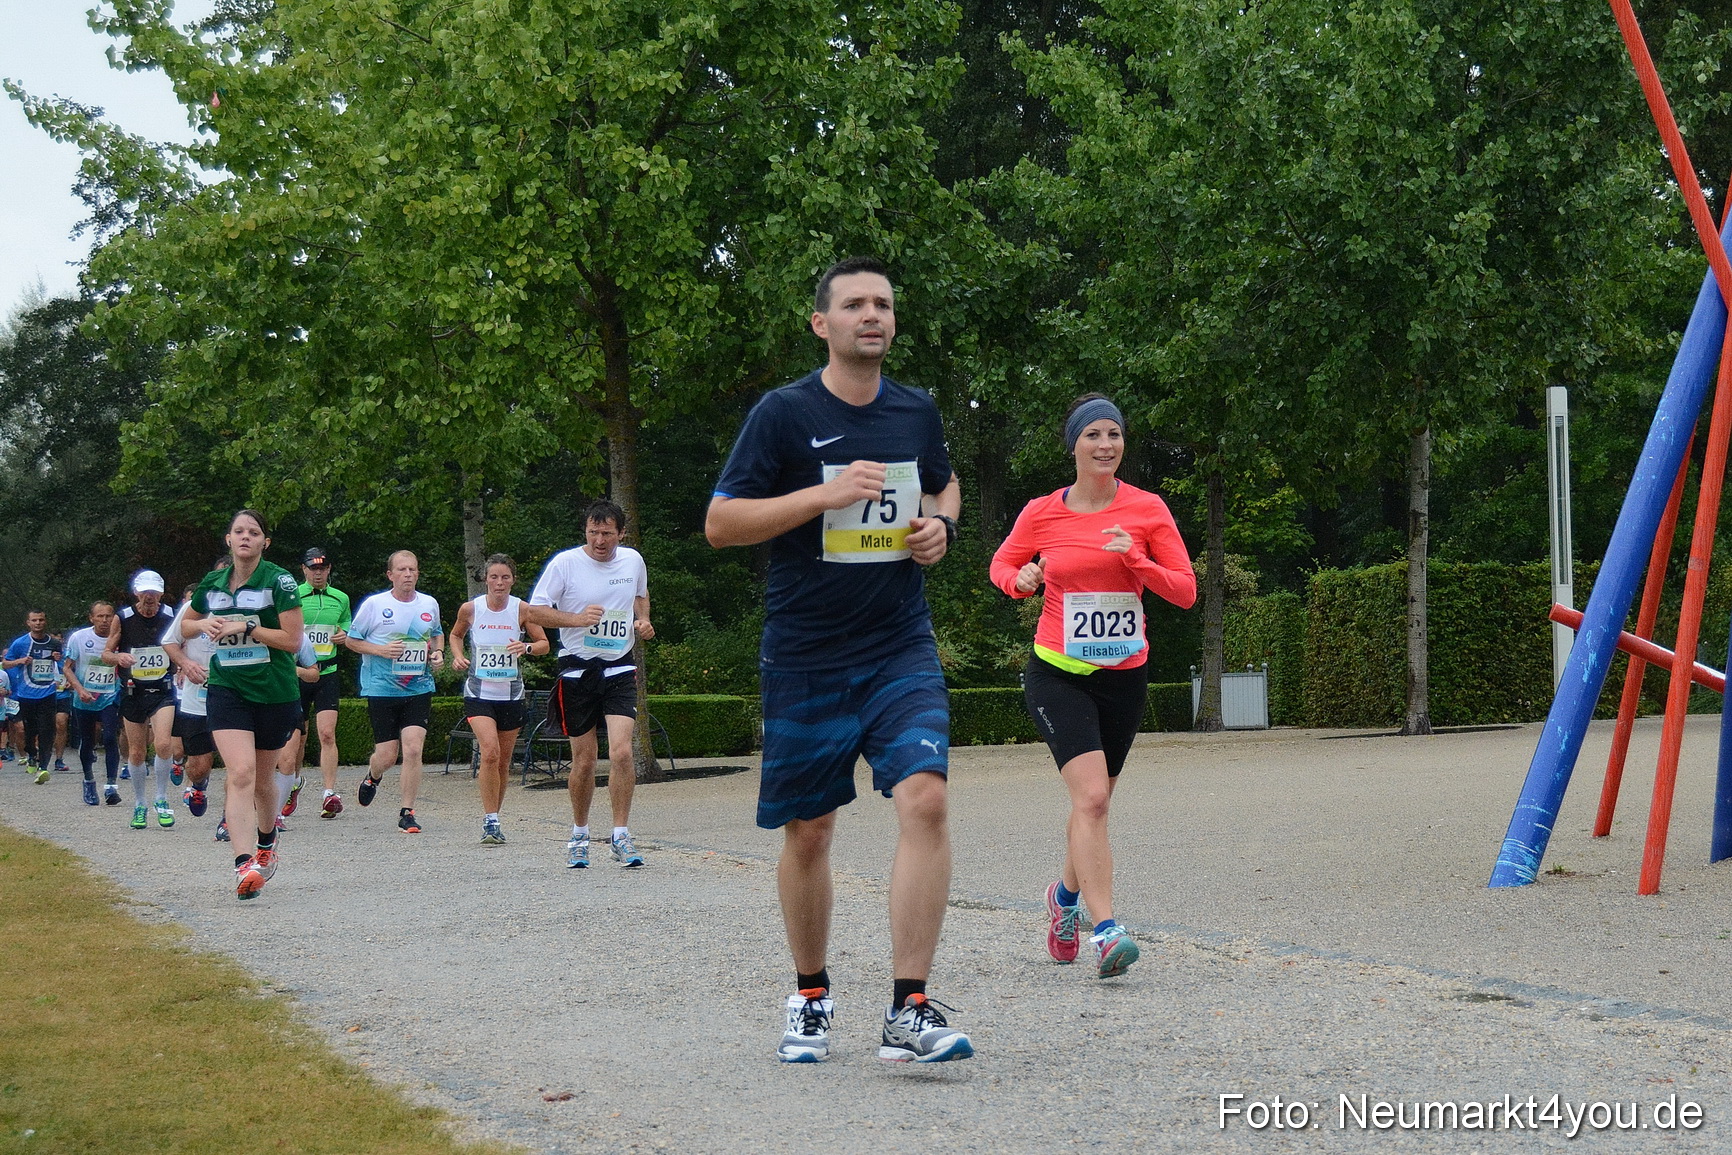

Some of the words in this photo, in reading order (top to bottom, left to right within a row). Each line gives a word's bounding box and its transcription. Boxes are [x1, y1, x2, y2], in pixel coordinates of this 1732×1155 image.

[861, 489, 898, 524] 75
[861, 535, 893, 548] Mate
[1101, 595, 1138, 605] BOCK
[590, 620, 627, 637] 3105
[1073, 610, 1136, 638] 2023
[308, 631, 329, 644] 608
[228, 650, 254, 659] Andrea
[397, 649, 426, 663] 2270
[1082, 645, 1130, 657] Elisabeth
[140, 654, 164, 668] 243
[481, 653, 512, 668] 2341
[88, 671, 114, 683] 2412
